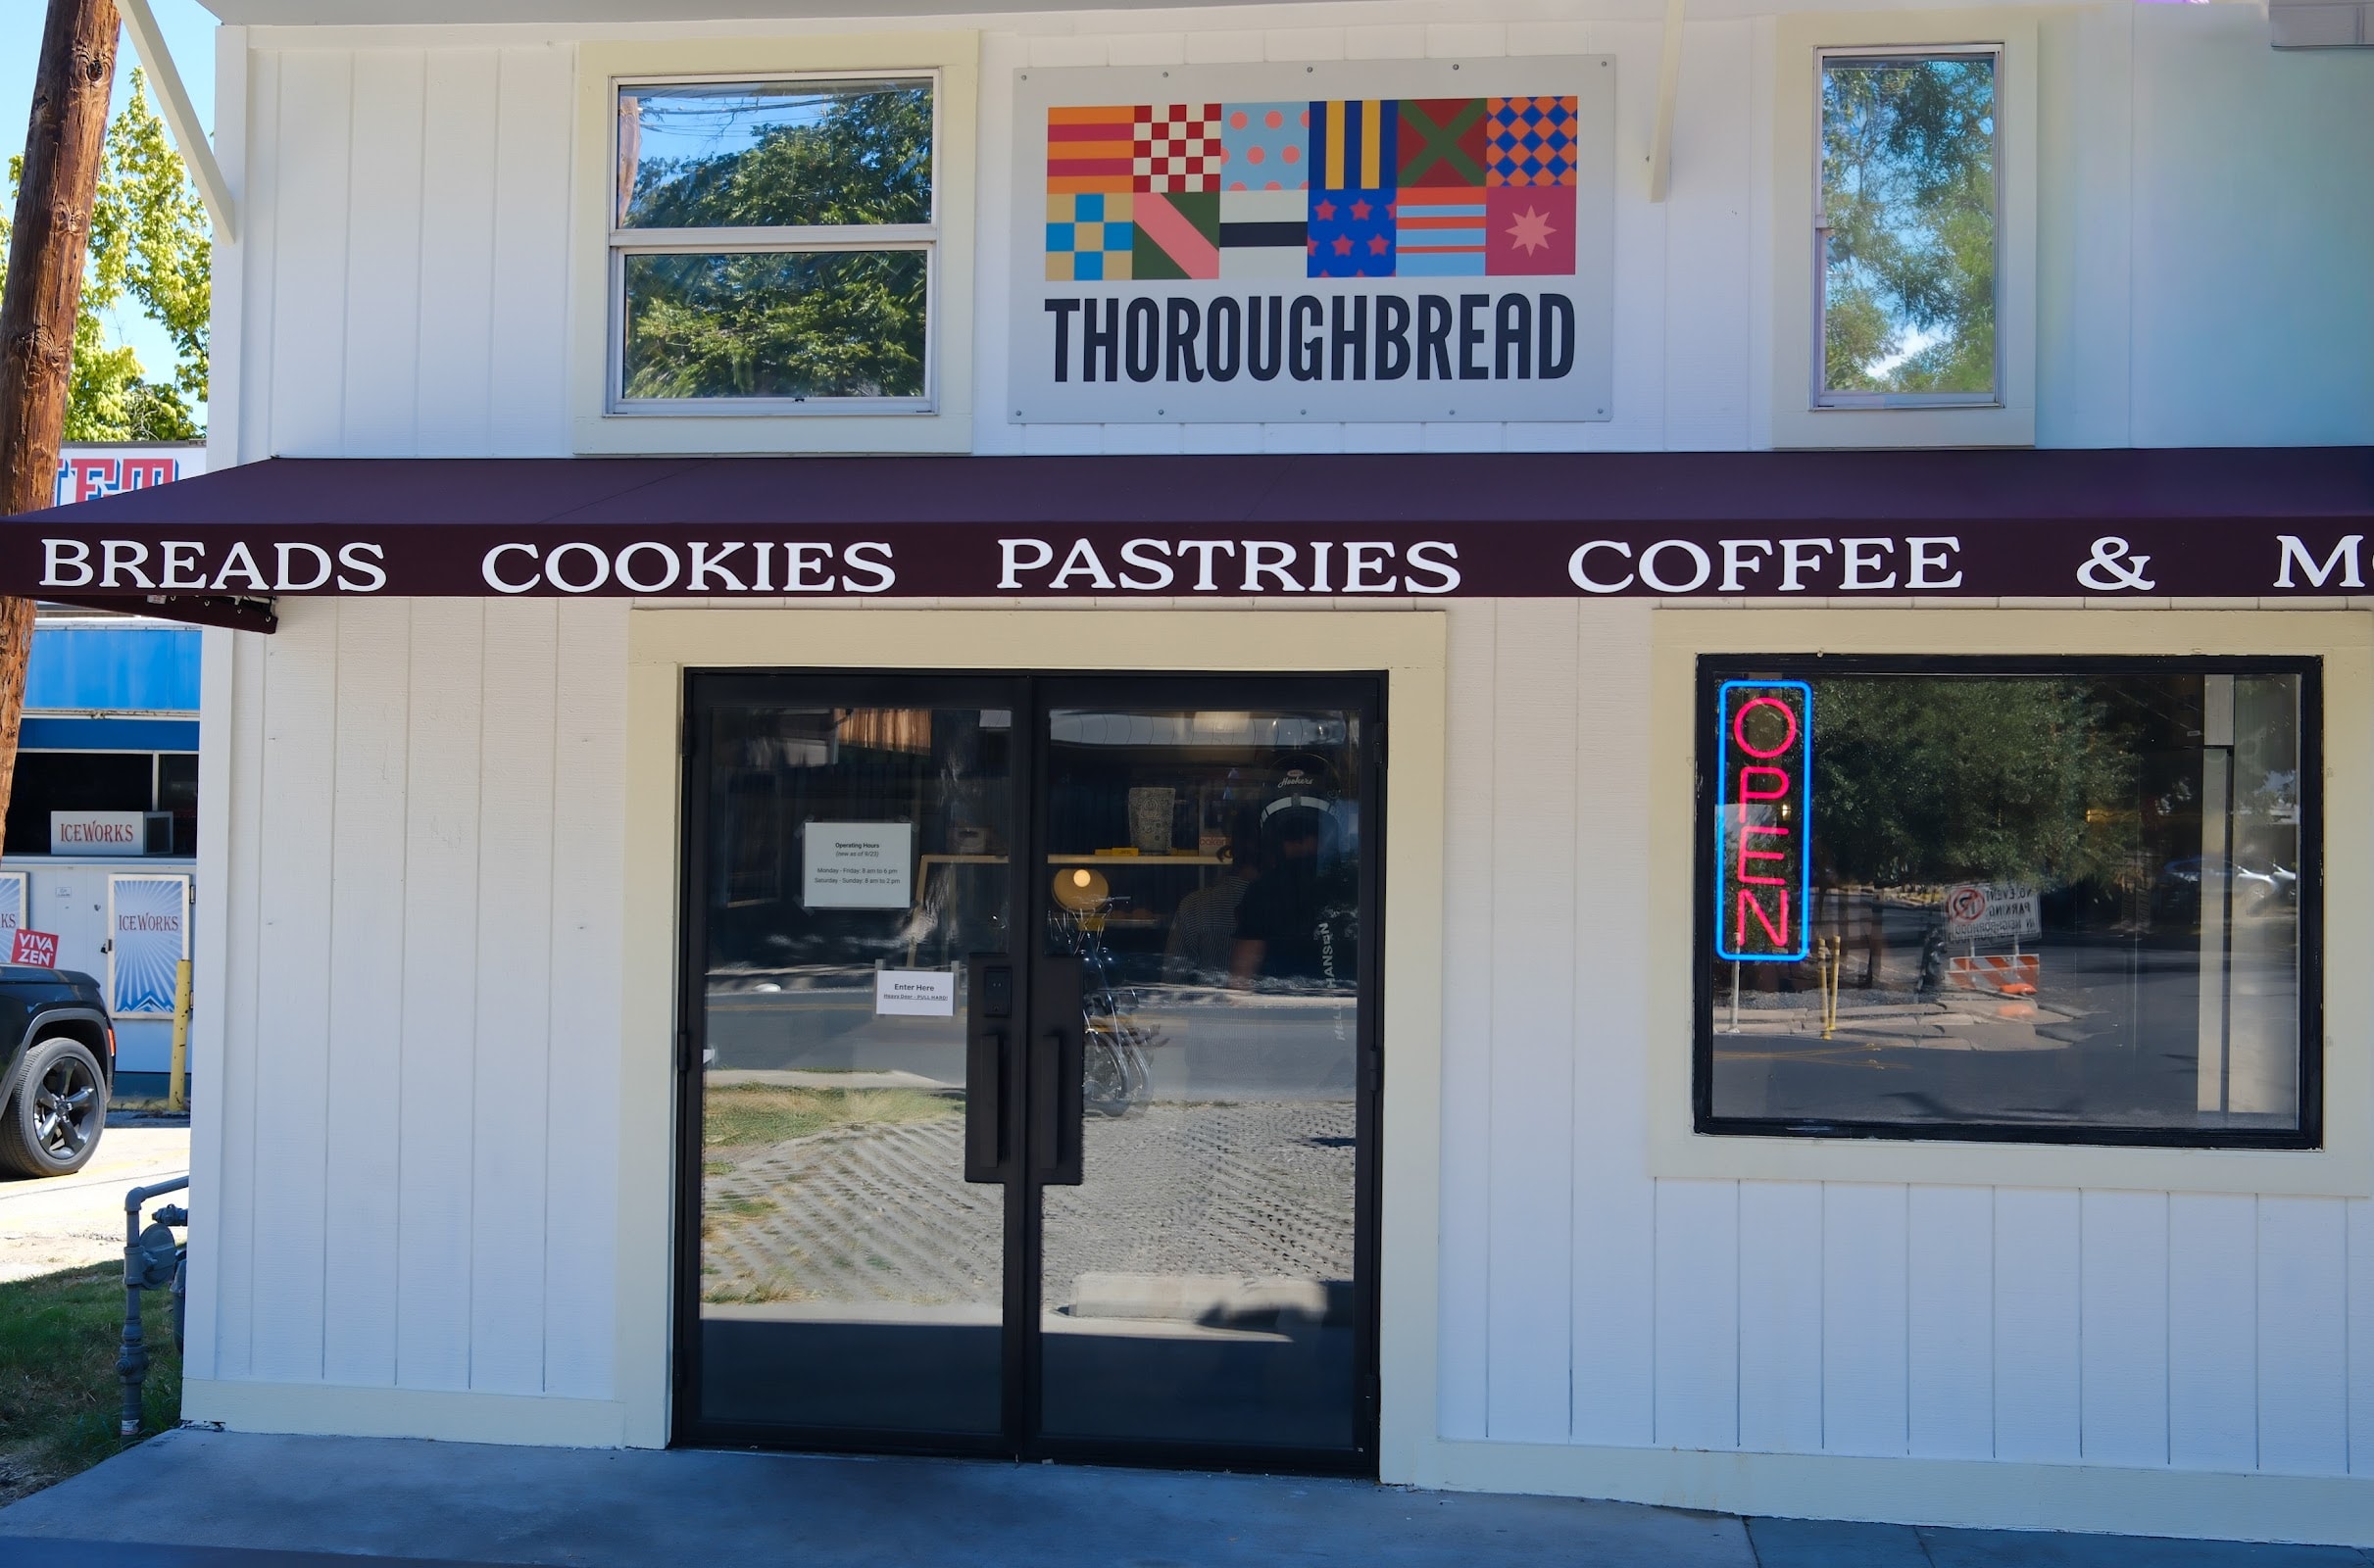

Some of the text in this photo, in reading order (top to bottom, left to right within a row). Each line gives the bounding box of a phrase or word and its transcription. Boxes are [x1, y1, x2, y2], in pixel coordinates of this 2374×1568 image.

[1045, 293, 1575, 383] THOROUGHBREAD
[39, 534, 2374, 594] BREADS COOKIES PASTRIES COFFEE & M
[60, 820, 134, 843] ICEWORKS
[1732, 696, 1799, 948] OPEN
[19, 932, 54, 953] VIVA
[119, 912, 179, 932] ICEWORKS
[1317, 922, 1338, 989] HANSEN
